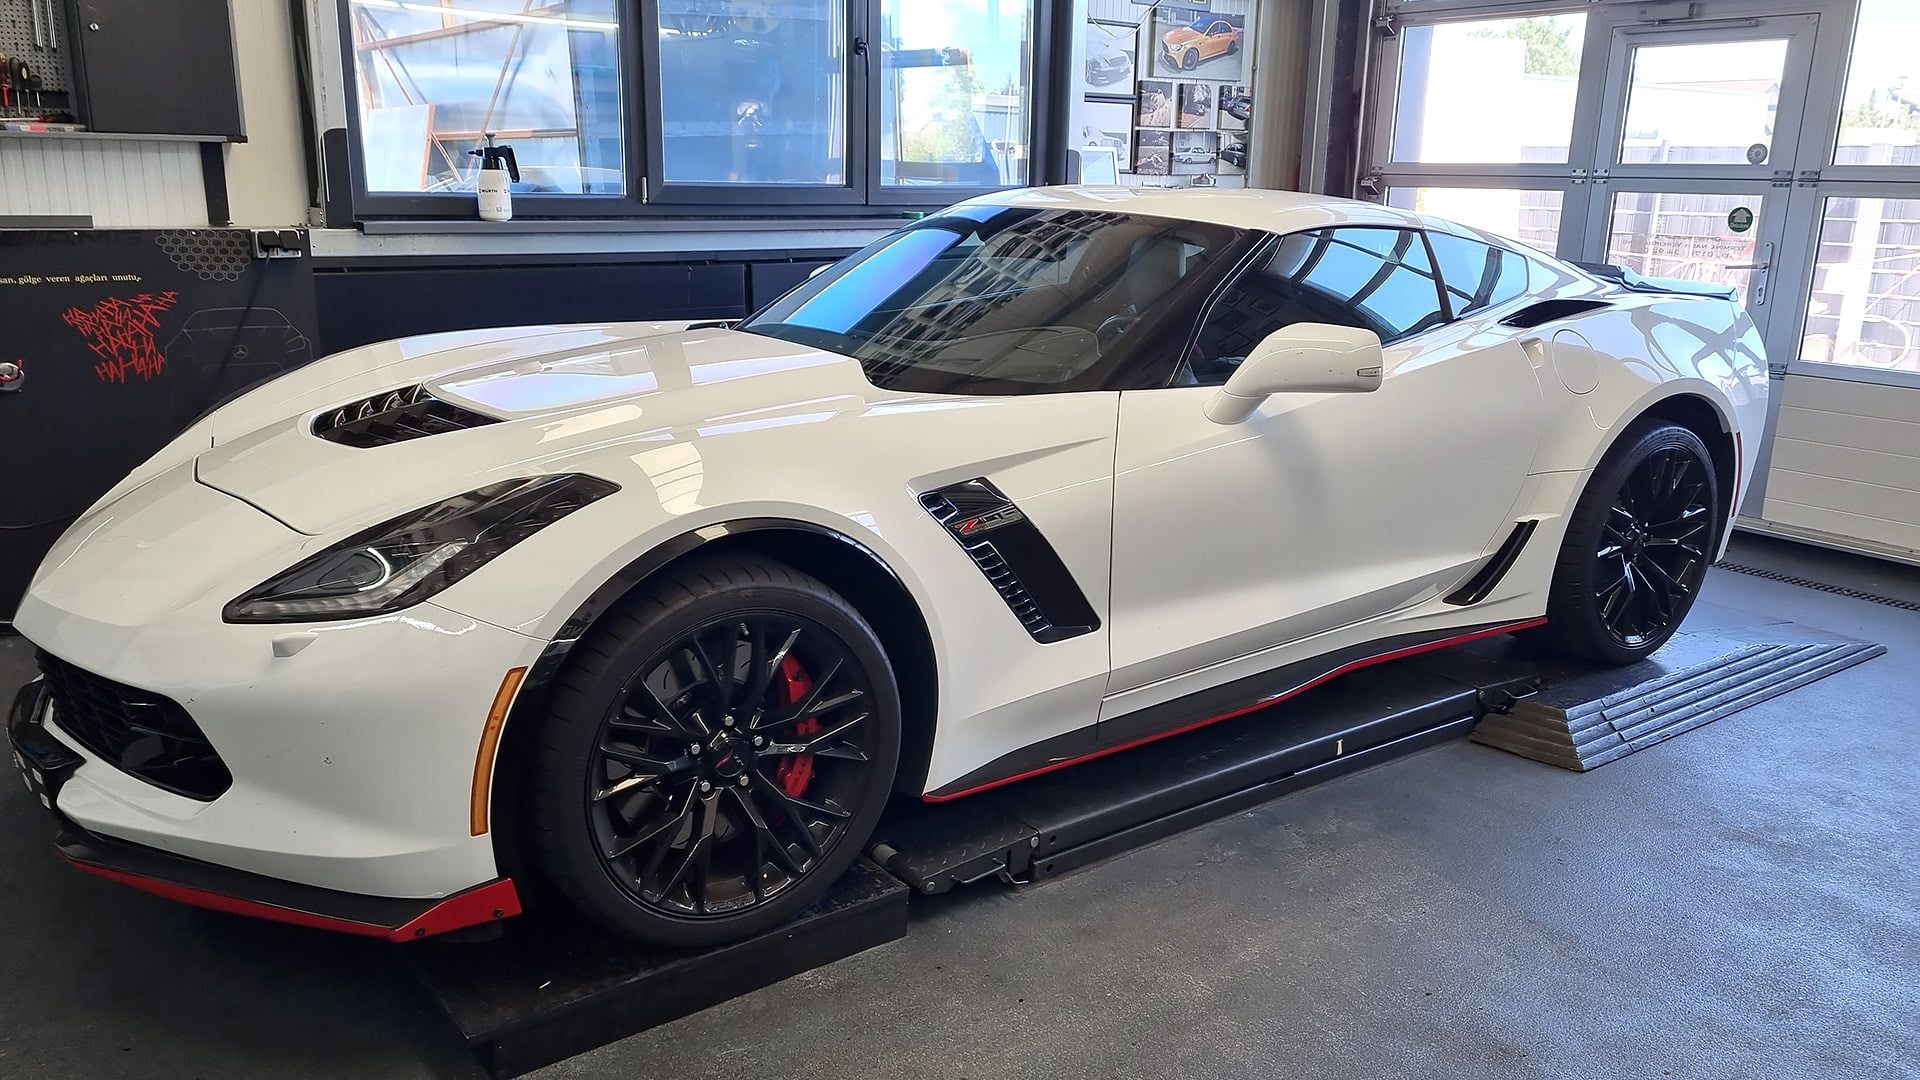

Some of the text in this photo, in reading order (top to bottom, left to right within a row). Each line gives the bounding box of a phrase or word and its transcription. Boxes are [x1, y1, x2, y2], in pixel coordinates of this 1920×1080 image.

[18, 274, 42, 285] gölge
[45, 275, 71, 283] veren
[74, 273, 108, 283] ağaçları
